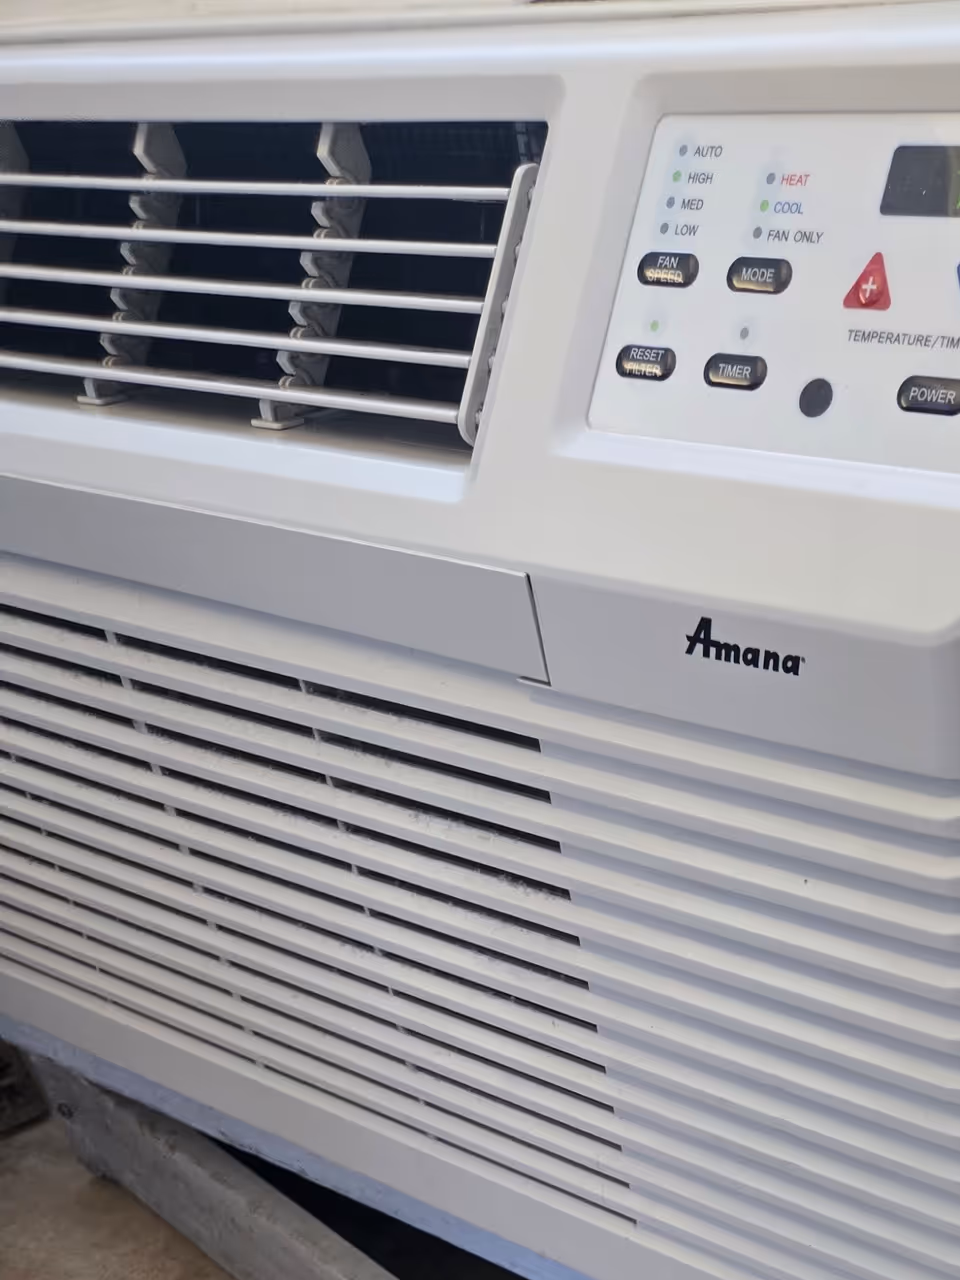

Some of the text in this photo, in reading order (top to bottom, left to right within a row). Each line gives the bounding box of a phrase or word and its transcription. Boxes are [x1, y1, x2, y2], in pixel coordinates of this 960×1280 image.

[694, 145, 723, 157] AUTO
[687, 173, 714, 185] HIGH
[780, 174, 810, 186] HEAT
[680, 199, 704, 210] MED
[773, 202, 804, 214] COOL
[674, 224, 699, 236] LOW
[767, 230, 824, 244] FAN ONLY
[657, 256, 679, 268] FAN
[647, 269, 684, 284] SPEED
[740, 267, 775, 282] MODE
[629, 348, 665, 361] RESET
[626, 362, 662, 377] FILTER
[718, 364, 751, 378] TIMER
[909, 387, 956, 404] POWER
[685, 616, 801, 676] Amana
